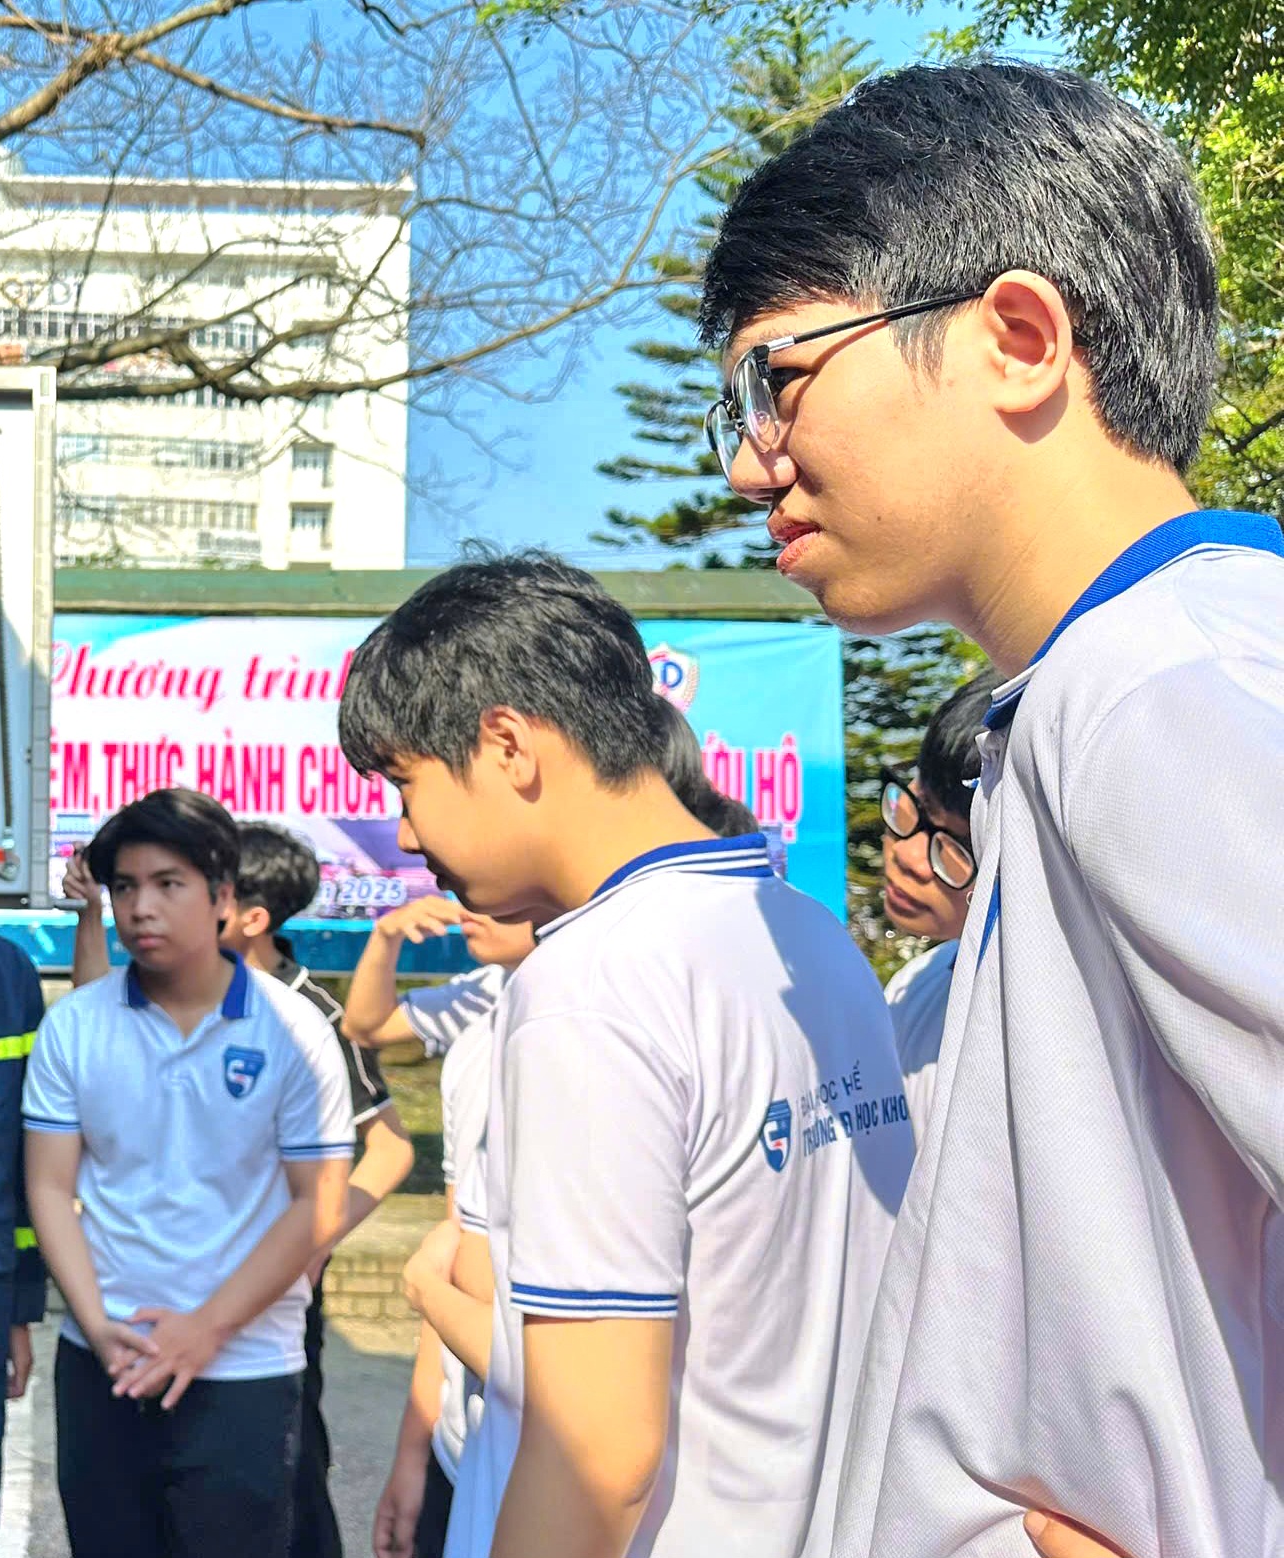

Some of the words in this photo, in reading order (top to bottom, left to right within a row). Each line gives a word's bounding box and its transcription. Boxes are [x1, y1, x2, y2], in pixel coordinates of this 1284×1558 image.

[197, 728, 286, 812] HÀNH
[756, 733, 799, 838] HỘ
[342, 879, 402, 900] 2025
[855, 1100, 878, 1136] HỌC
